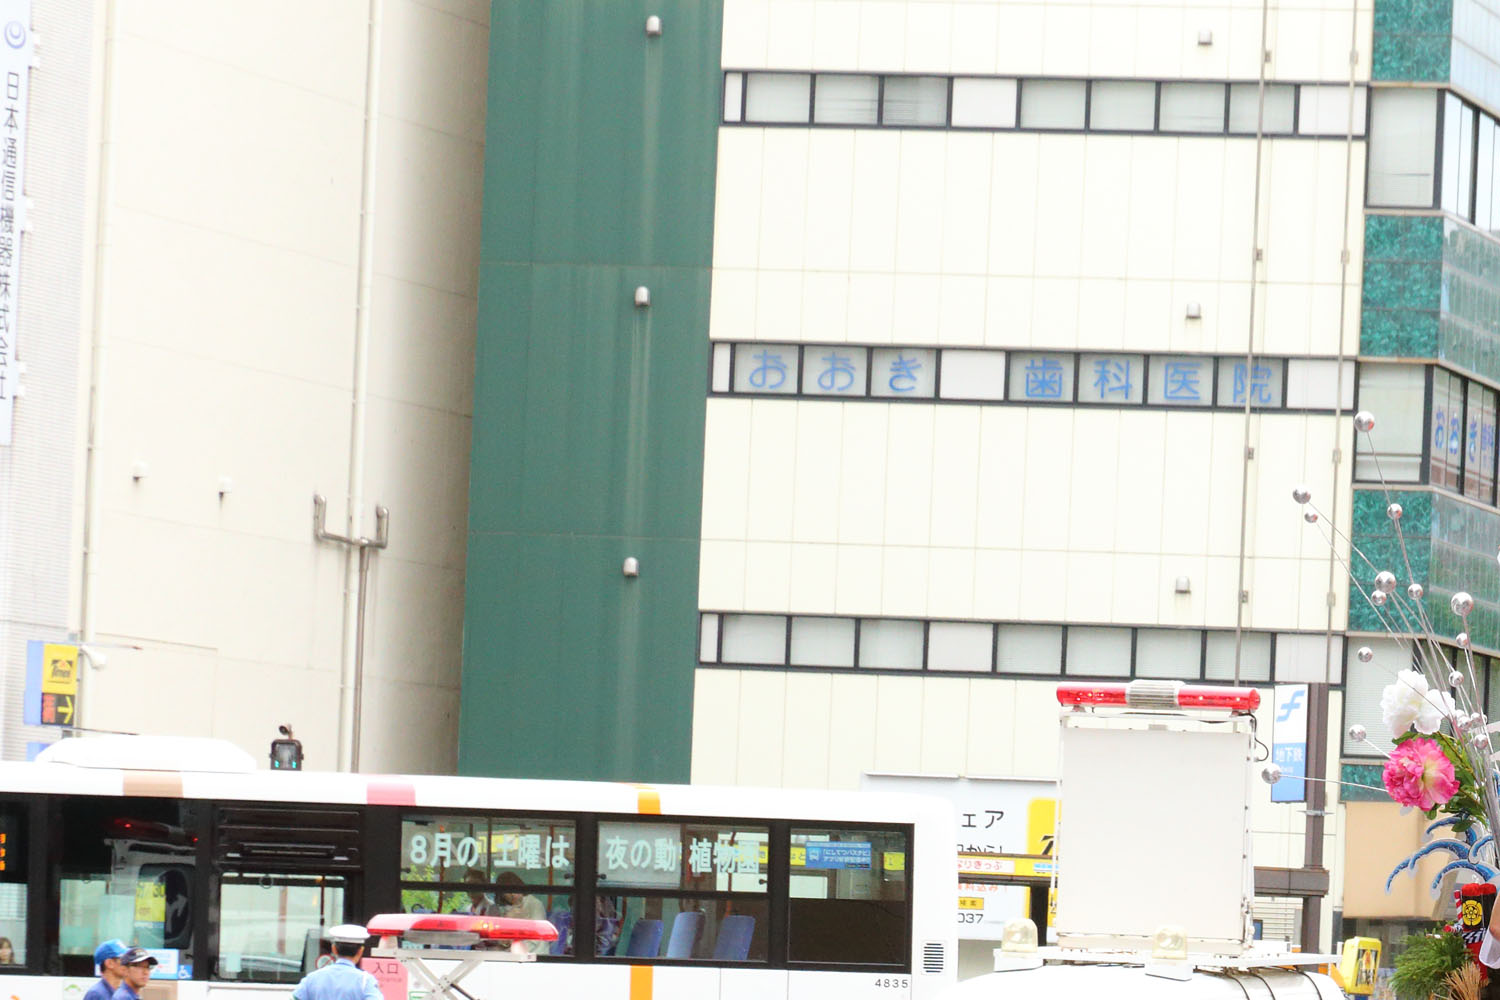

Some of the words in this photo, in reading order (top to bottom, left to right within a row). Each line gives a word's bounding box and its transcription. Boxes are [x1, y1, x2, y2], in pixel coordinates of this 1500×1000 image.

[749, 350, 921, 395] おおき
[1025, 356, 1273, 405] 歯科医院
[373, 962, 399, 974] 入口
[875, 979, 908, 988] 4835
